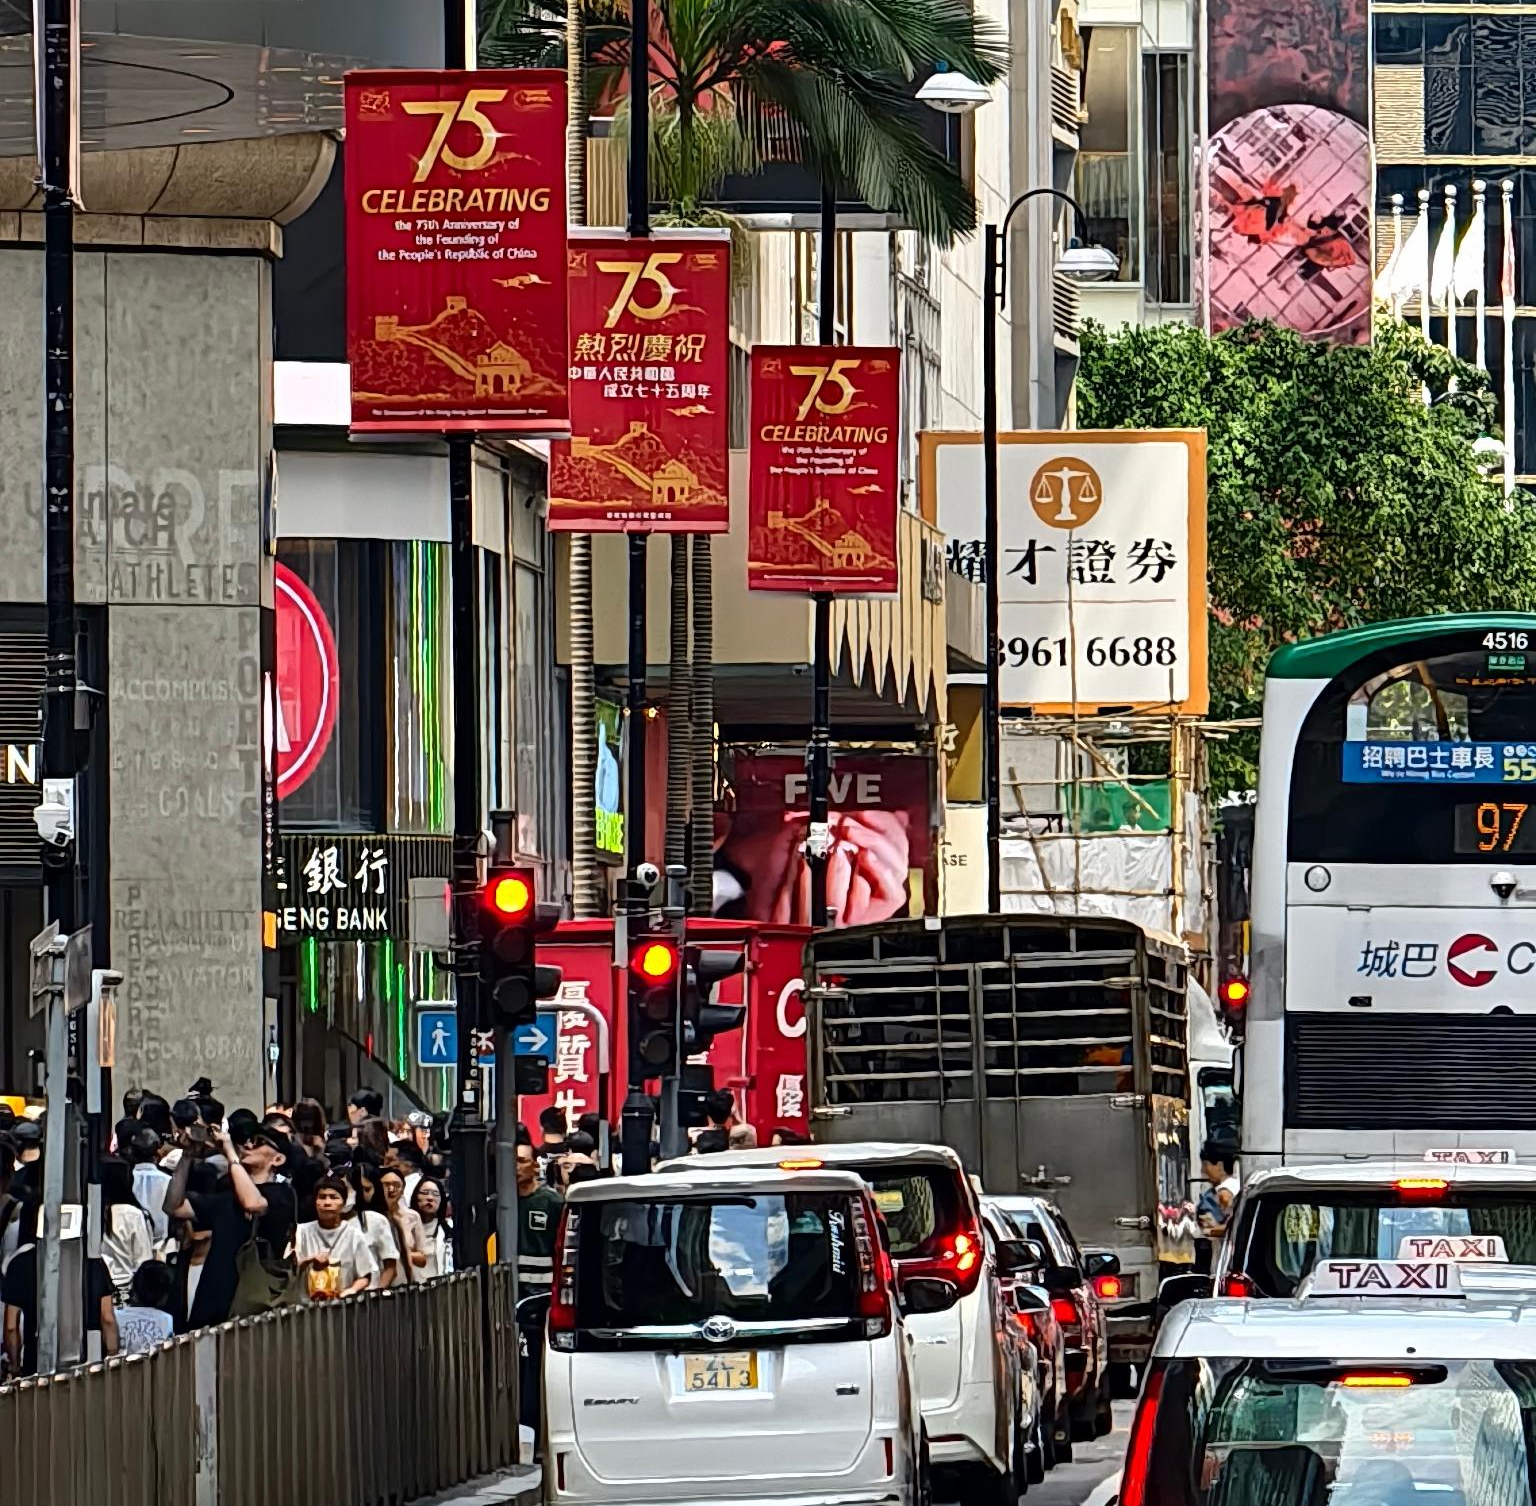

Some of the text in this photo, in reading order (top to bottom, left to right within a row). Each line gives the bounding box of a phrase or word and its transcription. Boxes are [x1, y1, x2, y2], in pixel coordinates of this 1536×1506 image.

[402, 89, 508, 182] 75
[361, 187, 551, 214] CELEBRATING
[595, 252, 684, 329] 75
[574, 332, 707, 363] 熱烈慶祝
[789, 359, 862, 422] 75
[760, 424, 889, 444] CELEBRATING
[1087, 636, 1178, 667] 6688
[1482, 631, 1529, 650] 4516
[1362, 745, 1495, 770] 招聘巴士車長
[784, 773, 882, 805] FVE
[1476, 802, 1529, 853] 97
[337, 906, 389, 931] BANK
[1356, 940, 1440, 979] 城巴
[1431, 1151, 1510, 1164] TAXI
[1410, 1238, 1496, 1258] TAXI
[1329, 1263, 1448, 1289] TAXI
[691, 1370, 752, 1390] 5413
